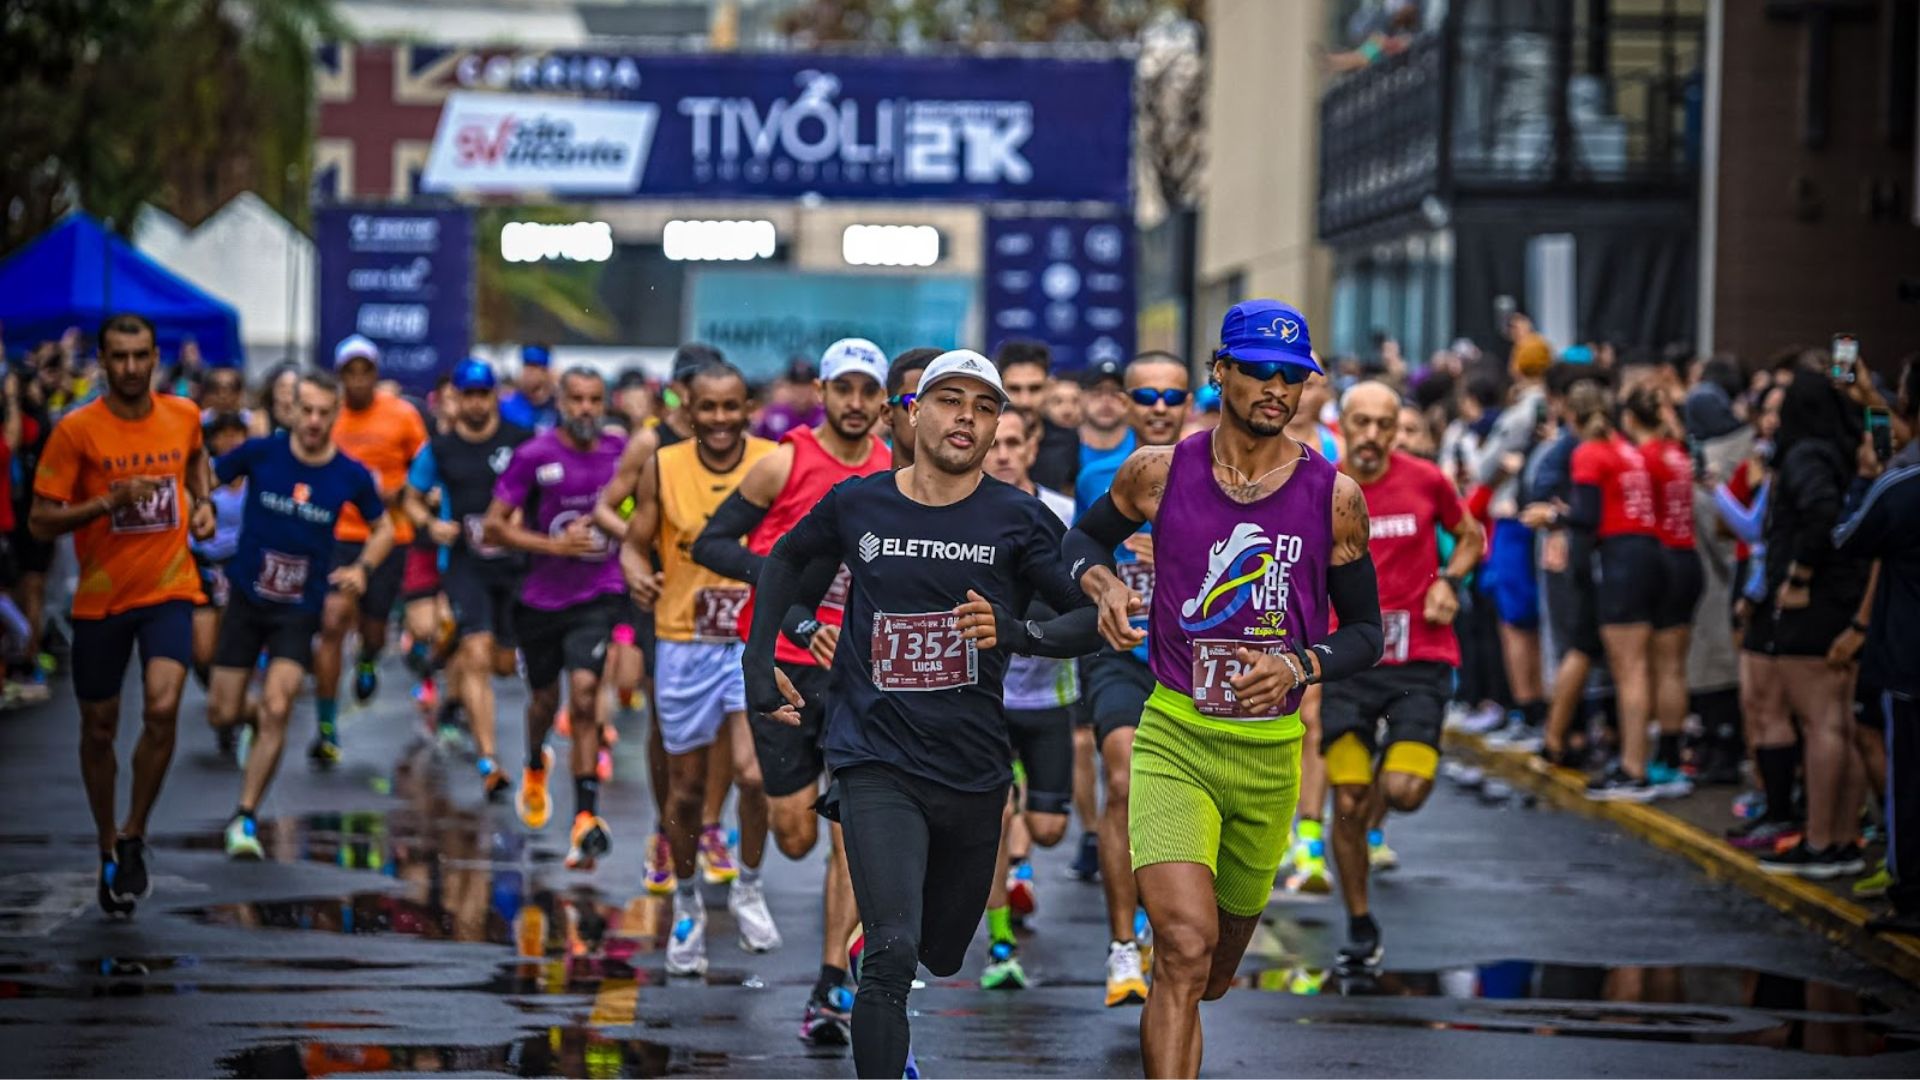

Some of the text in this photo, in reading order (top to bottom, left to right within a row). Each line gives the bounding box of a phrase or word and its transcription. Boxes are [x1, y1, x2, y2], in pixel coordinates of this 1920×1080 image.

[457, 55, 640, 89] CORRIDA
[904, 121, 1033, 183] 21K
[882, 538, 996, 565] ELETROMEI
[1275, 534, 1302, 563] FO
[1251, 584, 1290, 611] VER
[888, 631, 961, 660] 1352
[912, 661, 943, 672] LUCAS
[1203, 659, 1251, 688] 13
